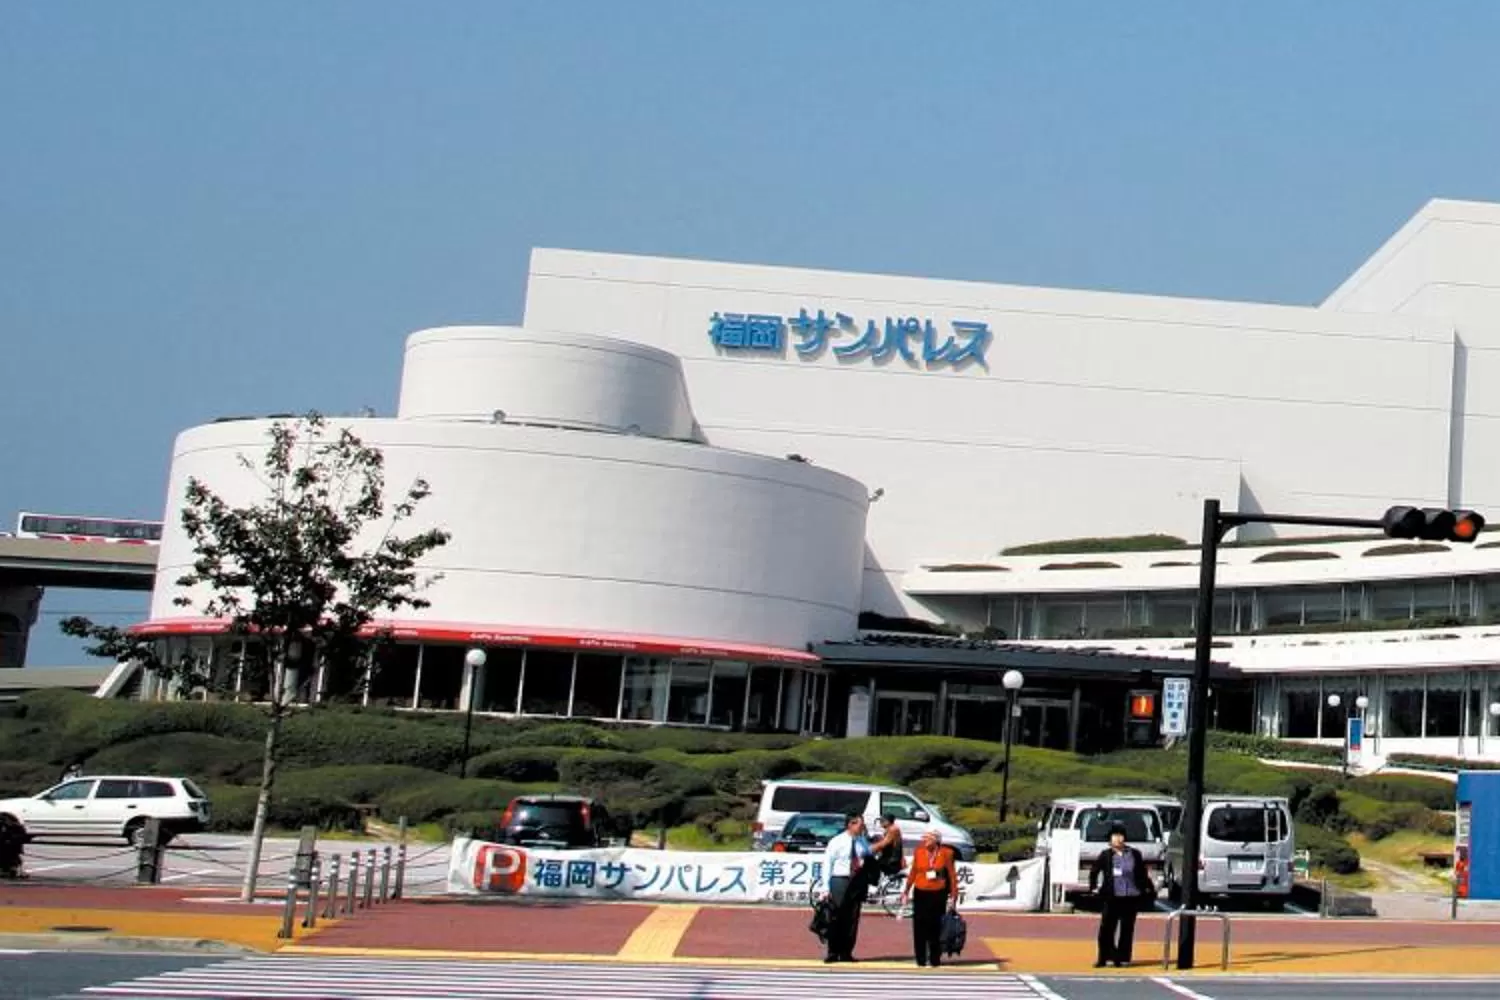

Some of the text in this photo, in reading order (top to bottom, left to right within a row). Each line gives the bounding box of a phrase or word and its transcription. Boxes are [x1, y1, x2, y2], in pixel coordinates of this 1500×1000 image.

[707, 307, 991, 368] 福岡サンパレス
[481, 848, 521, 892] P
[534, 858, 747, 893] 福岡サンパレス
